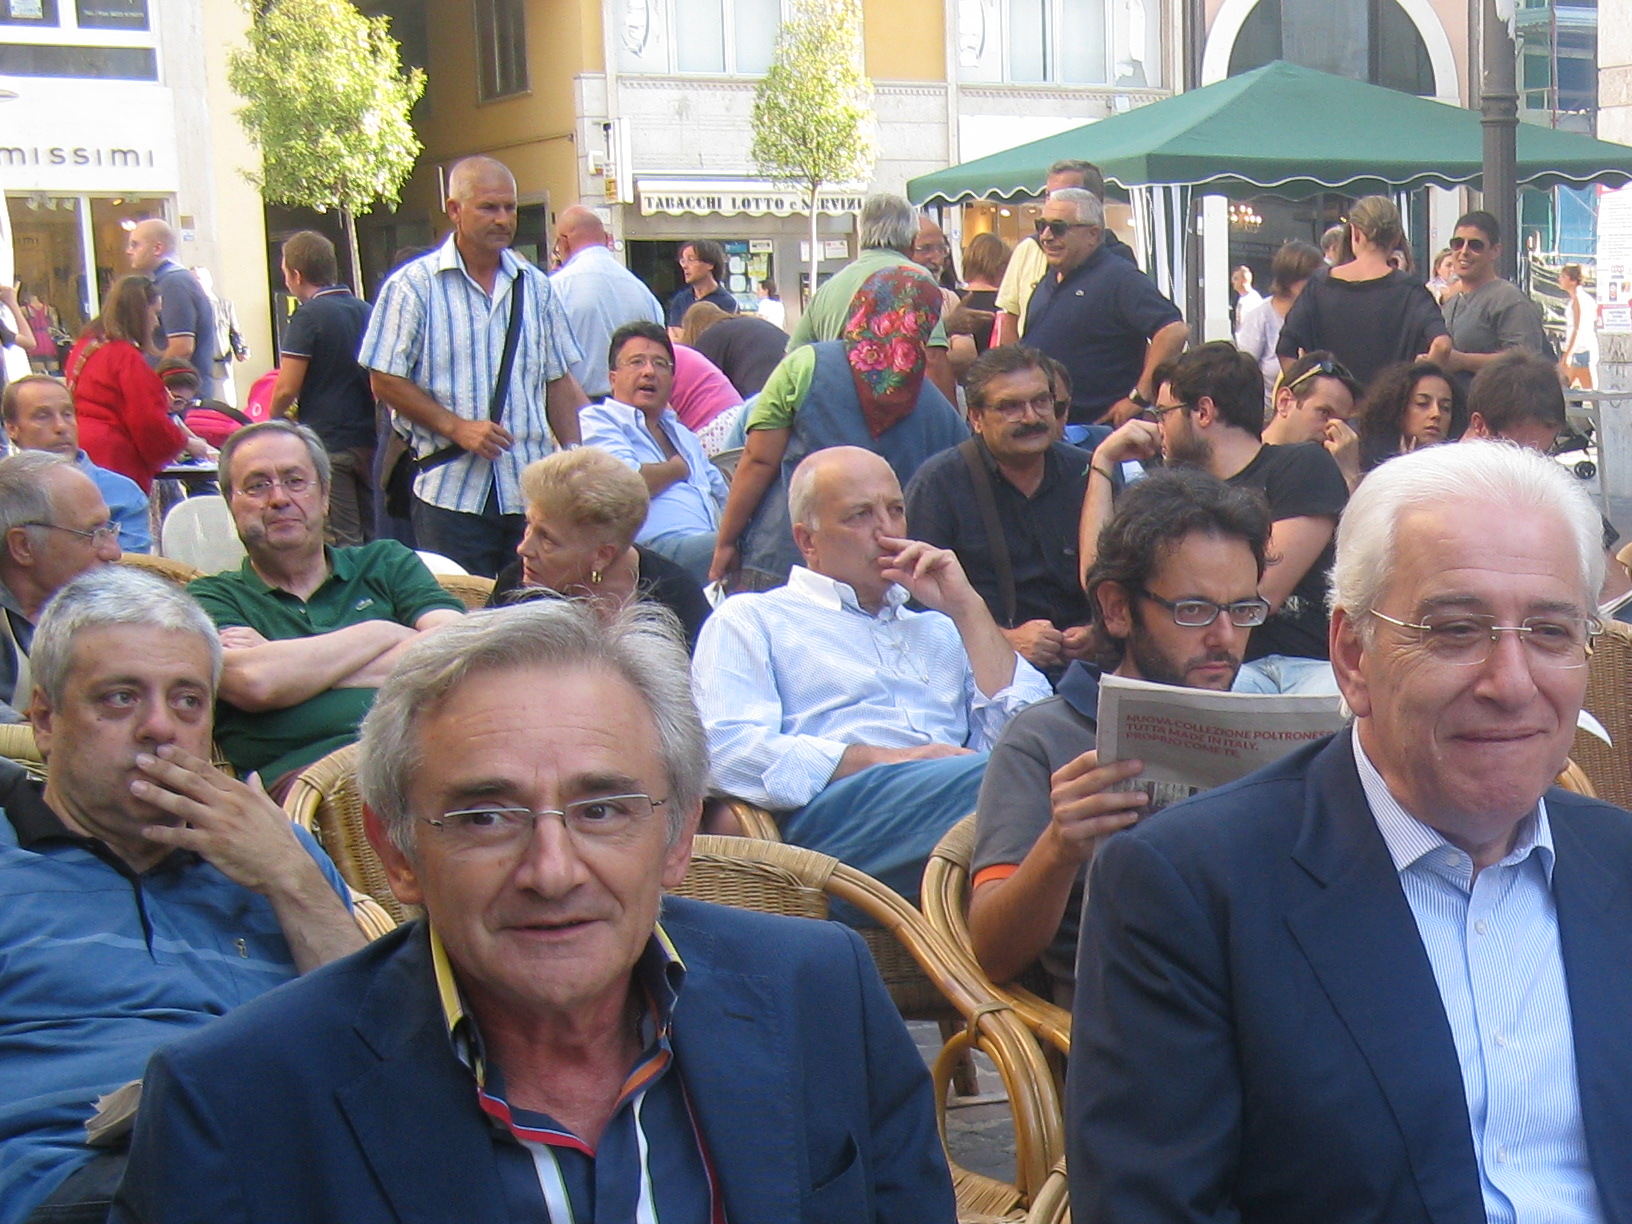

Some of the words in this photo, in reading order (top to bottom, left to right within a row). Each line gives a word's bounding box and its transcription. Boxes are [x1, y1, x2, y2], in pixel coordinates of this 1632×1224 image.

[644, 196, 722, 210] TABACCHI
[731, 197, 785, 210] LOTTO
[1126, 714, 1172, 726] NUOVA
[1174, 720, 1252, 740] COLLEZIONE
[1127, 722, 1166, 735] TUTTA
[1168, 728, 1205, 743] MADE
[1207, 735, 1221, 746] IN
[1126, 732, 1182, 747] PROPRIO
[1184, 740, 1220, 754] COME
